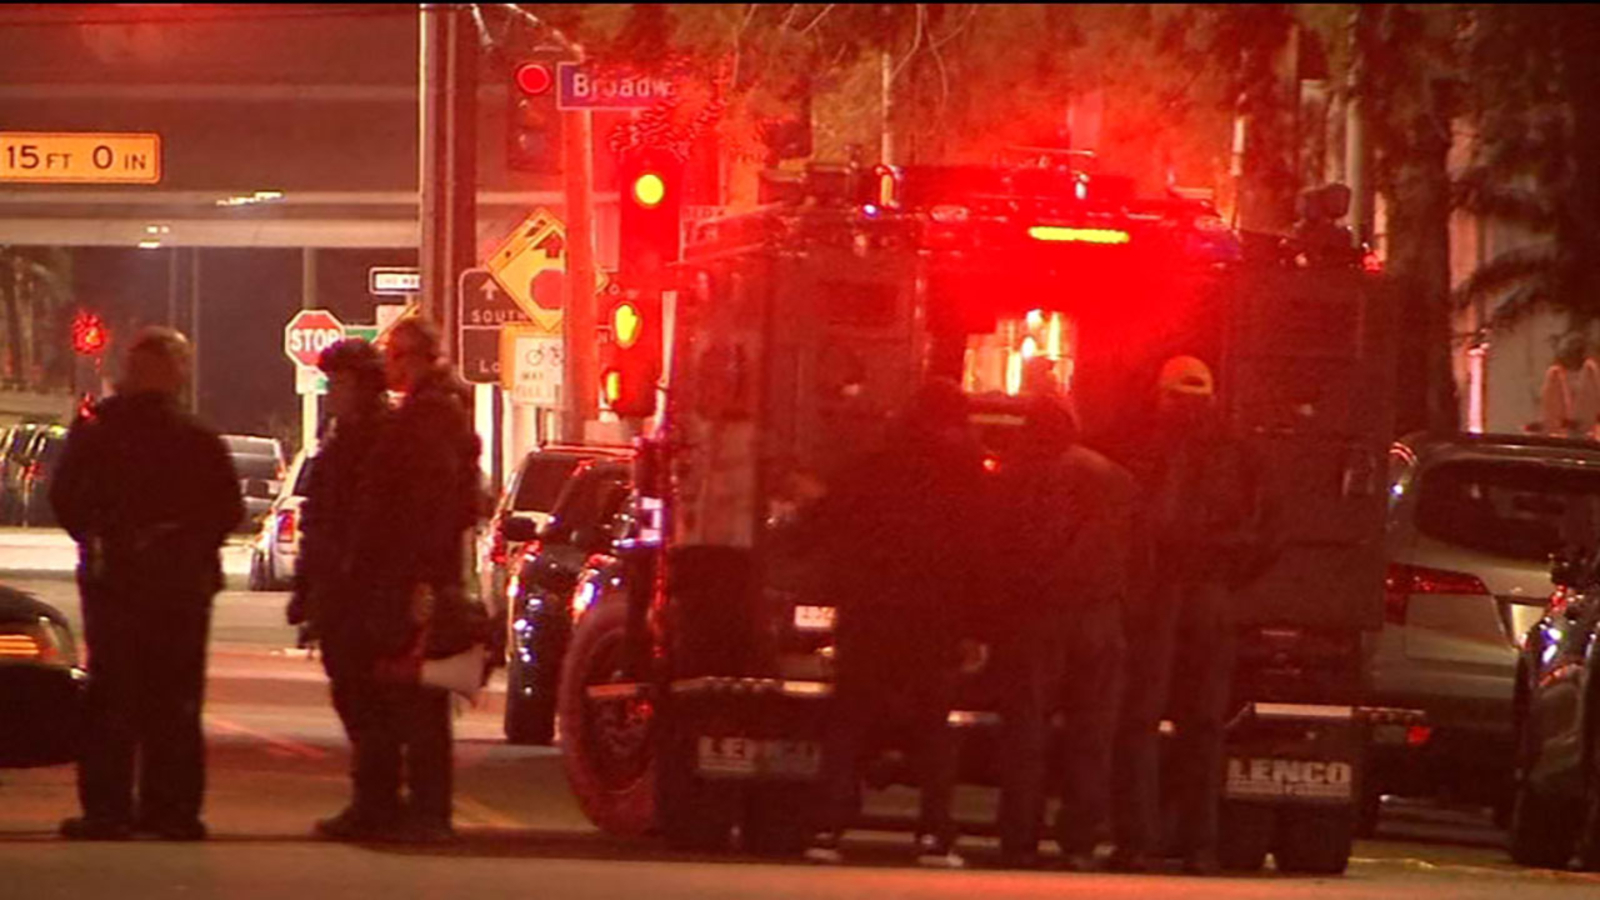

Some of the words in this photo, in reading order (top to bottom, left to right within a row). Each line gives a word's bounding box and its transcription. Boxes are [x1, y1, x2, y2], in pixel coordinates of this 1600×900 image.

[572, 72, 674, 98] Broadw
[7, 145, 40, 169] 15
[46, 153, 72, 169] FT
[124, 154, 146, 170] IN
[290, 329, 339, 352] STOP
[1227, 758, 1352, 785] LENCO
